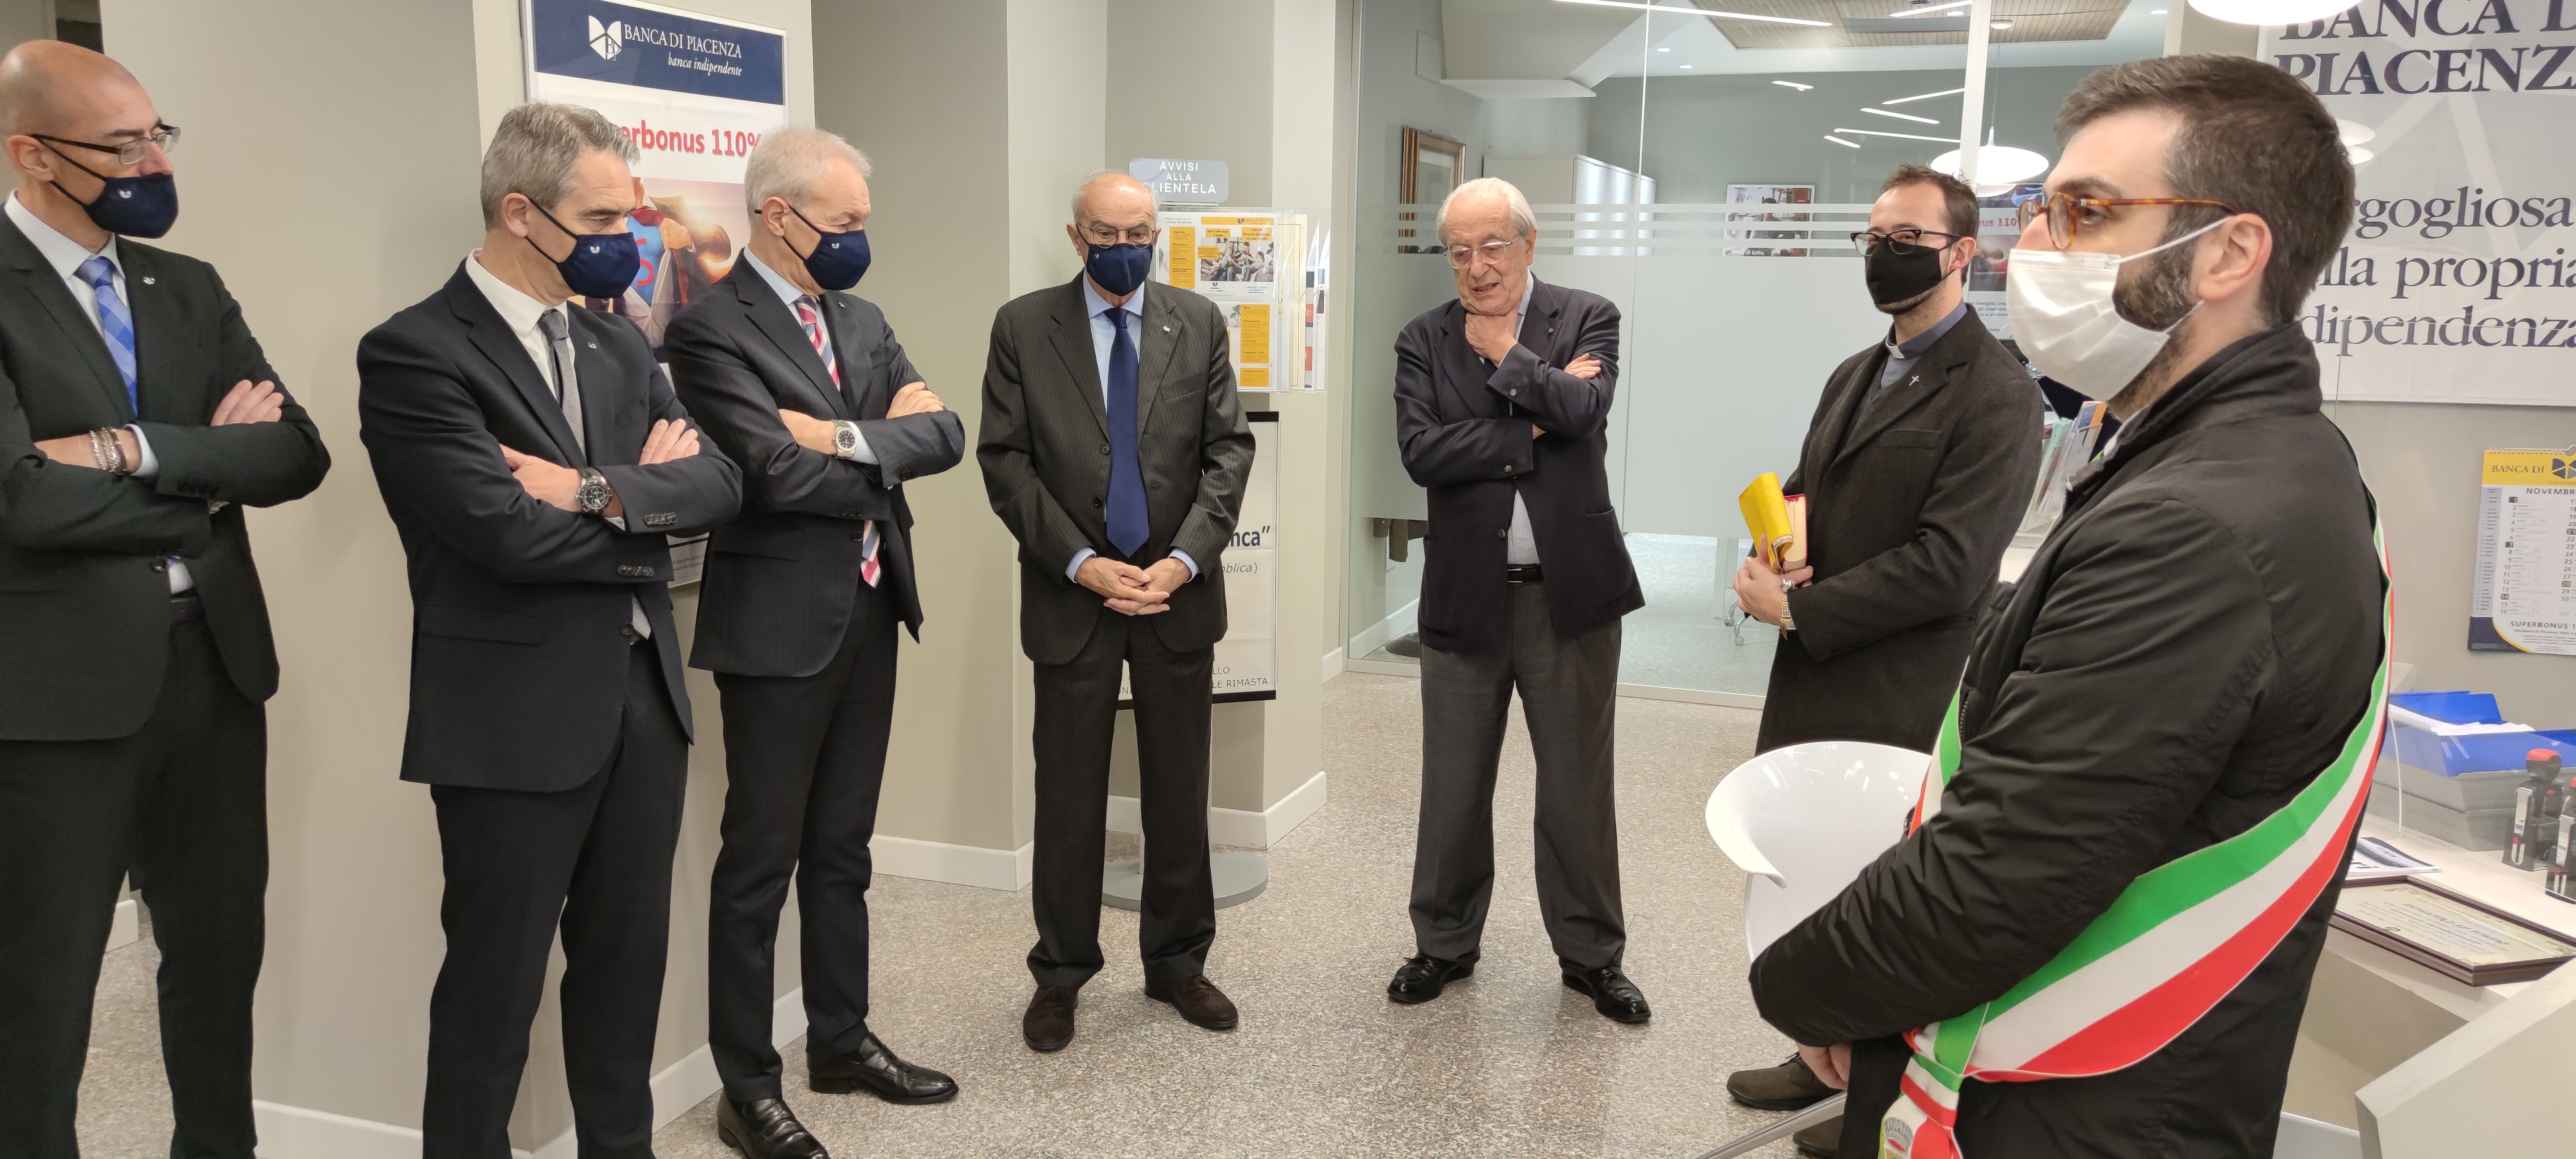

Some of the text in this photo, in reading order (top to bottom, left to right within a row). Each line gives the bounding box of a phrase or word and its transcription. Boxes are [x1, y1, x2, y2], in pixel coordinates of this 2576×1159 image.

[624, 24, 742, 59] BANCA DI PIACENZA
[668, 52, 742, 76] banca indipendente
[2273, 44, 2576, 95] PIACENZ
[1160, 161, 1198, 171] AVVISI
[1166, 173, 1192, 181] ALLA
[2354, 186, 2575, 239] gogliosa
[2510, 621, 2568, 629] SUPERBONUS
[1227, 677, 1268, 688] RIMASTA
